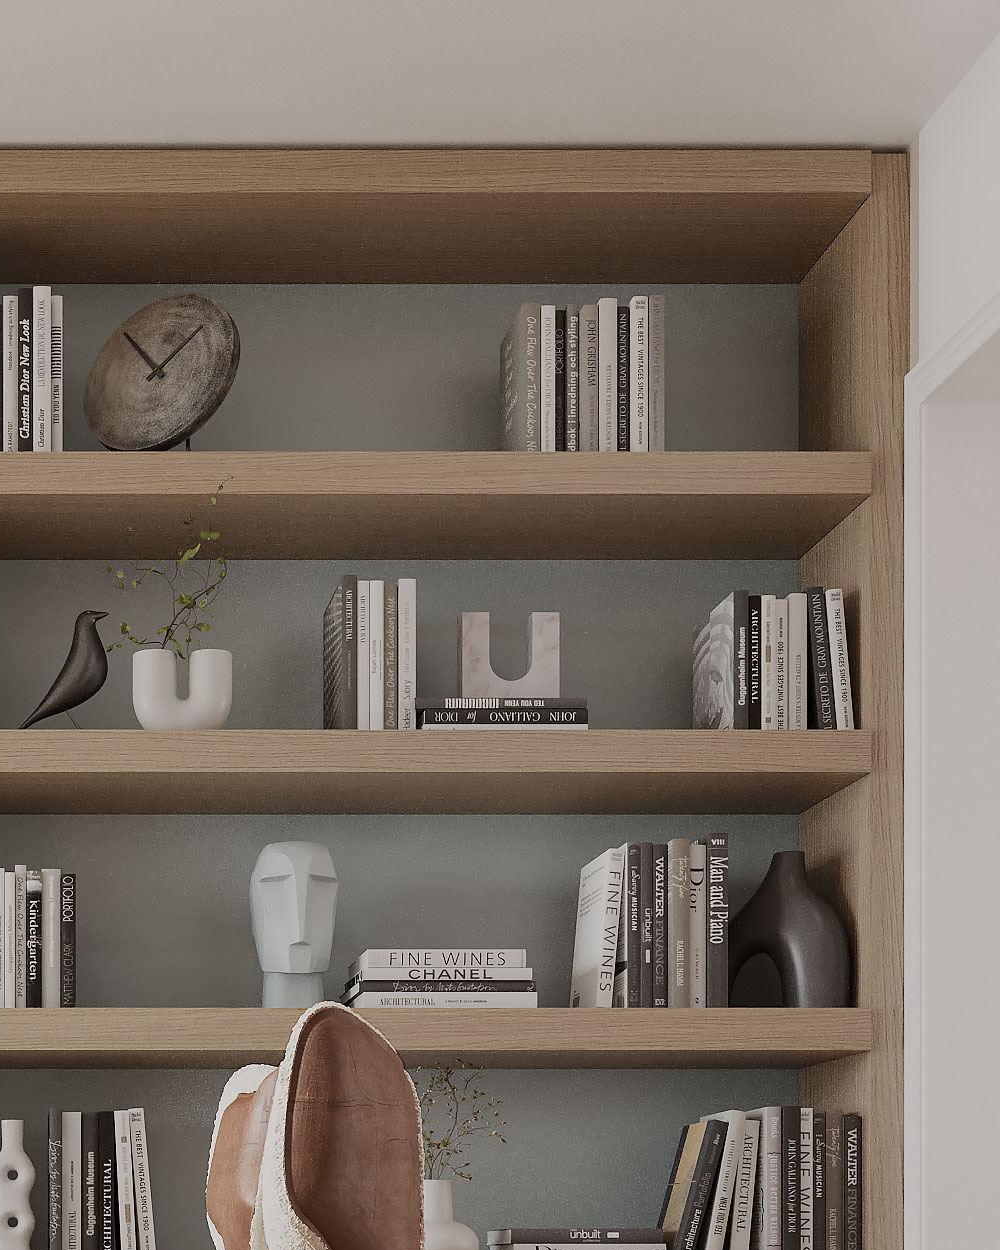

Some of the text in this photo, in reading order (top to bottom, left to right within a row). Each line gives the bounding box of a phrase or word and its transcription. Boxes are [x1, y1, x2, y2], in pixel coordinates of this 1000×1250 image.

[568, 316, 578, 348] styling
[586, 319, 596, 343] JOHN
[619, 313, 627, 363] MOUNTAIN
[568, 350, 576, 368] och
[587, 346, 596, 387] GRISHAM
[19, 319, 30, 439] Christian Dior New Look
[619, 364, 627, 388] GRAY
[568, 371, 578, 417] inredning
[619, 392, 627, 404] DE
[568, 428, 576, 451] dbok
[619, 406, 627, 443] SECRETO
[345, 589, 353, 642] ARCHITECTURAL
[812, 593, 824, 643] MOUNTAIN
[386, 616, 395, 649] Cuckoos
[387, 651, 395, 666] The
[751, 609, 759, 704] ARCHITECTURAL
[817, 645, 827, 668] GRAY
[387, 668, 395, 688] Over
[738, 659, 747, 706] Guggenheim
[819, 671, 828, 683] DE
[387, 690, 395, 708] Flew
[820, 685, 832, 723] SECRETO
[387, 710, 395, 727] One
[434, 712, 458, 721] DIOR
[489, 712, 541, 722] GALLIANO
[549, 712, 577, 722] JOHN
[63, 876, 74, 922] PORTFOLIO
[690, 867, 704, 912] Dior
[709, 856, 728, 944] Man and Piano
[599, 871, 621, 992] FINE WINES
[644, 908, 652, 943] unbuilt
[656, 857, 664, 985] WALTER FINANCE
[27, 900, 39, 980] Kindergarten
[676, 940, 684, 962] RACHEL
[389, 952, 506, 966] FINE WINES
[408, 969, 493, 980] CHANEL
[64, 968, 74, 1004] MATTHEW
[676, 968, 684, 987] HAMM
[379, 998, 435, 1006] ARCHITECTURAL
[788, 1139, 797, 1160] JOHN
[86, 1151, 96, 1236] Guggenheim Museum
[736, 1133, 754, 1233] ARCHITECTURAL
[788, 1161, 797, 1202] GALLIANO
[847, 1127, 857, 1250] WALTER FINANCE
[569, 1229, 601, 1239] unbuilt
[788, 1212, 797, 1233] DIOR
